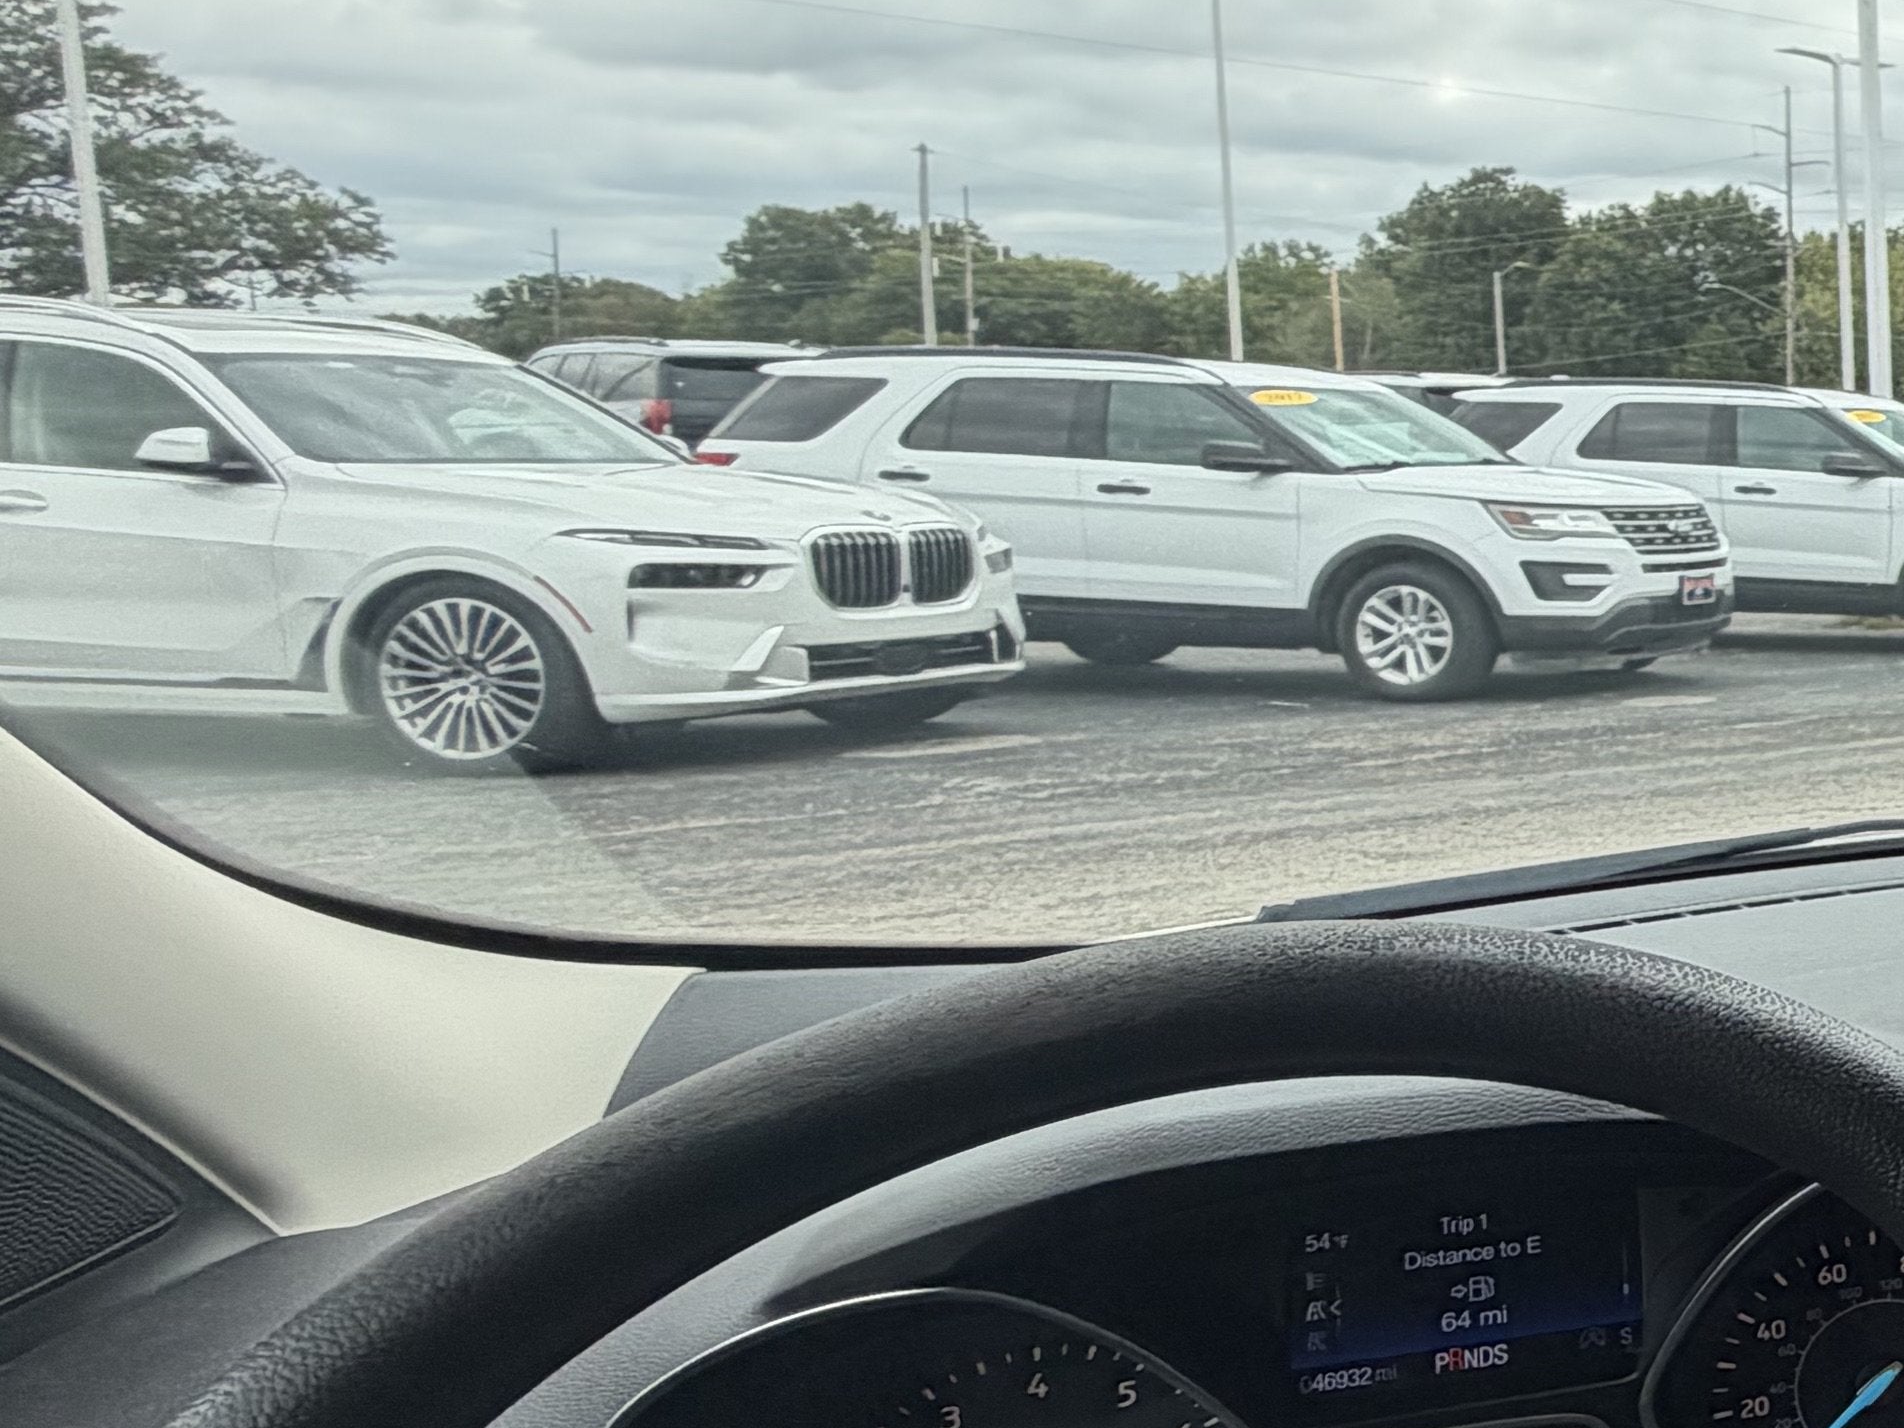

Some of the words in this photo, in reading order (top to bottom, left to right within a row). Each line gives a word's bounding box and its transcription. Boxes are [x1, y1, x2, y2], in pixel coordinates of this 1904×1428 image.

[1439, 1215, 1474, 1235] Trip
[1480, 1213, 1489, 1231] 1
[1403, 1244, 1495, 1271] Distance
[1499, 1240, 1521, 1259] to
[1526, 1235, 1542, 1254] E
[1817, 1263, 1848, 1286] 60
[1441, 1310, 1471, 1333] 64
[1479, 1304, 1509, 1328] mi
[1756, 1319, 1787, 1341] 40
[1026, 1373, 1049, 1399] 4
[1116, 1380, 1138, 1407] 5
[1740, 1396, 1771, 1419] 20
